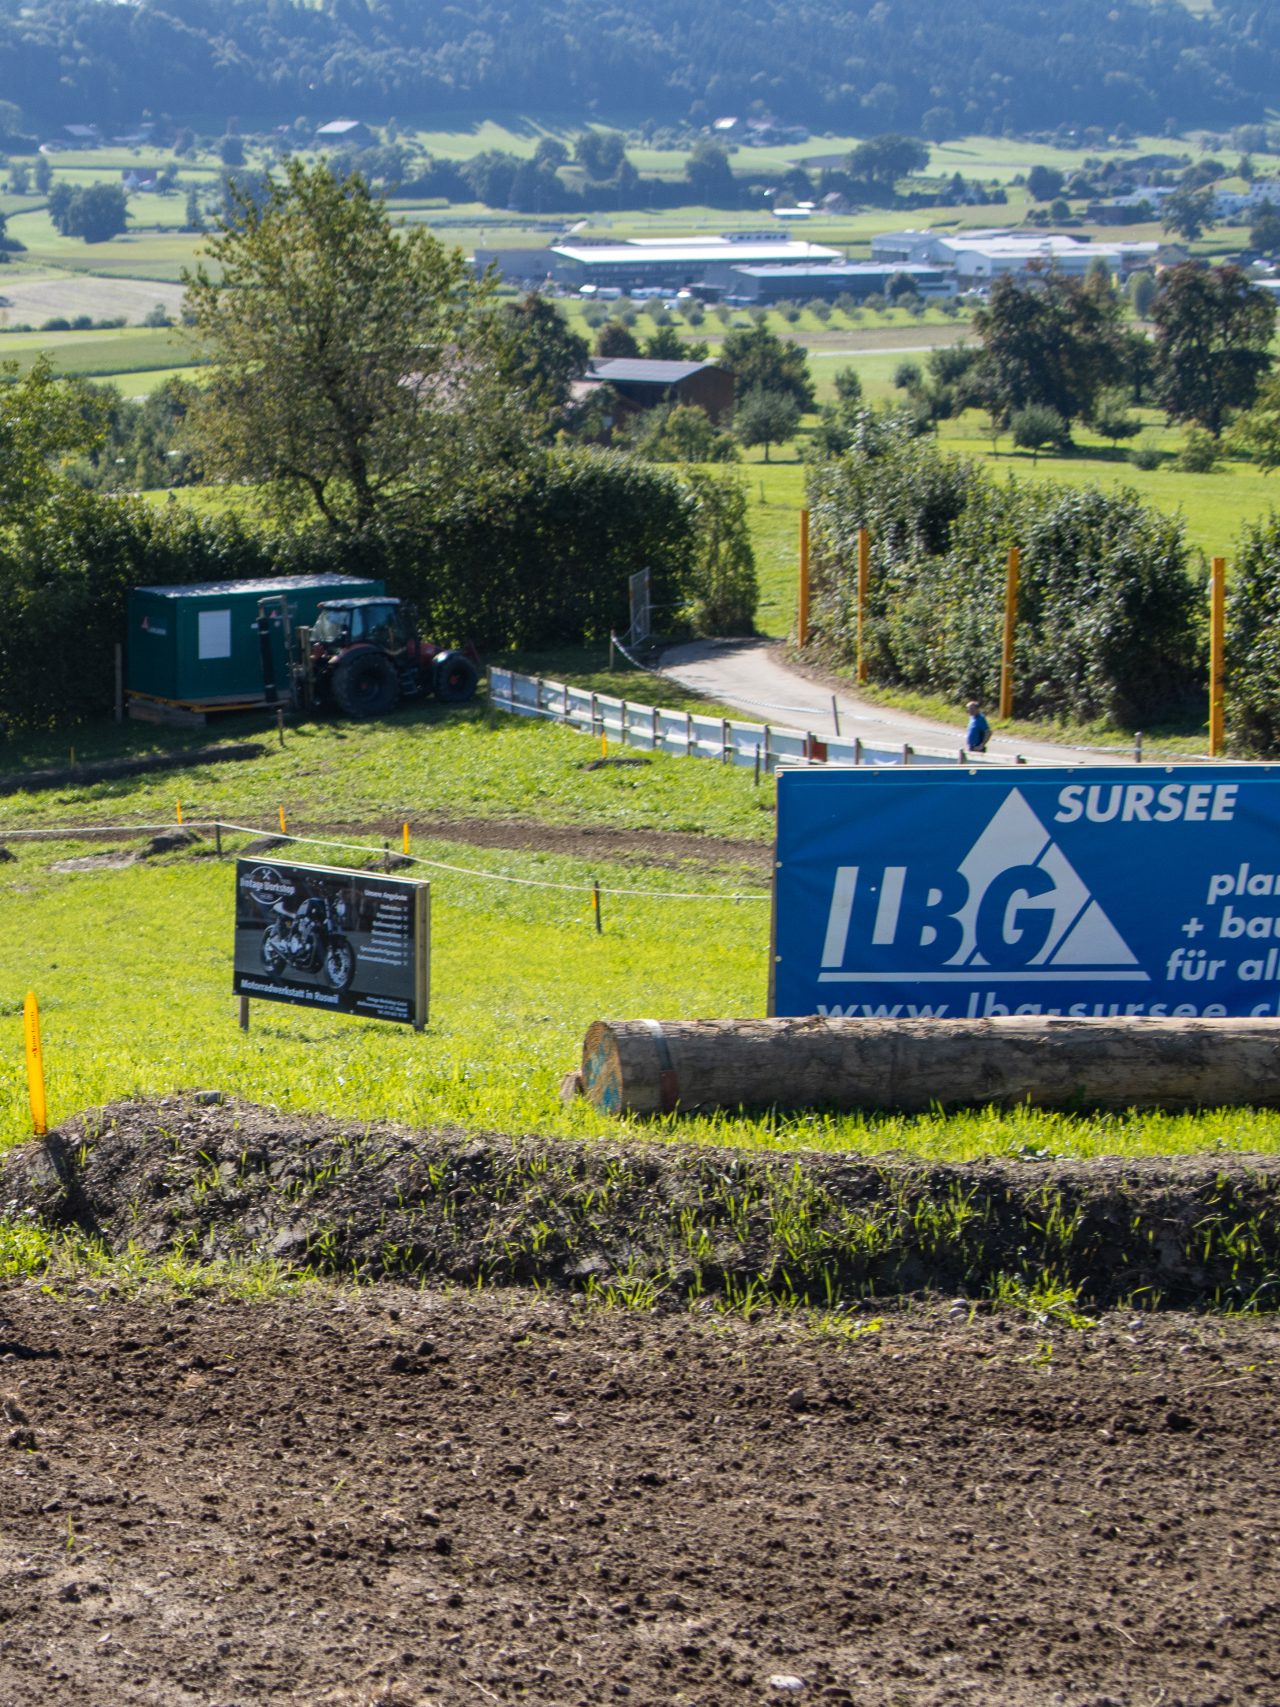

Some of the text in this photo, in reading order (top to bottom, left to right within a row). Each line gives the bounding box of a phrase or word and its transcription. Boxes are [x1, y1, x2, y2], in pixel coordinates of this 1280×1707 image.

[1054, 784, 1239, 822] SURSEE
[1181, 917, 1204, 938] +
[1166, 947, 1226, 981] für
